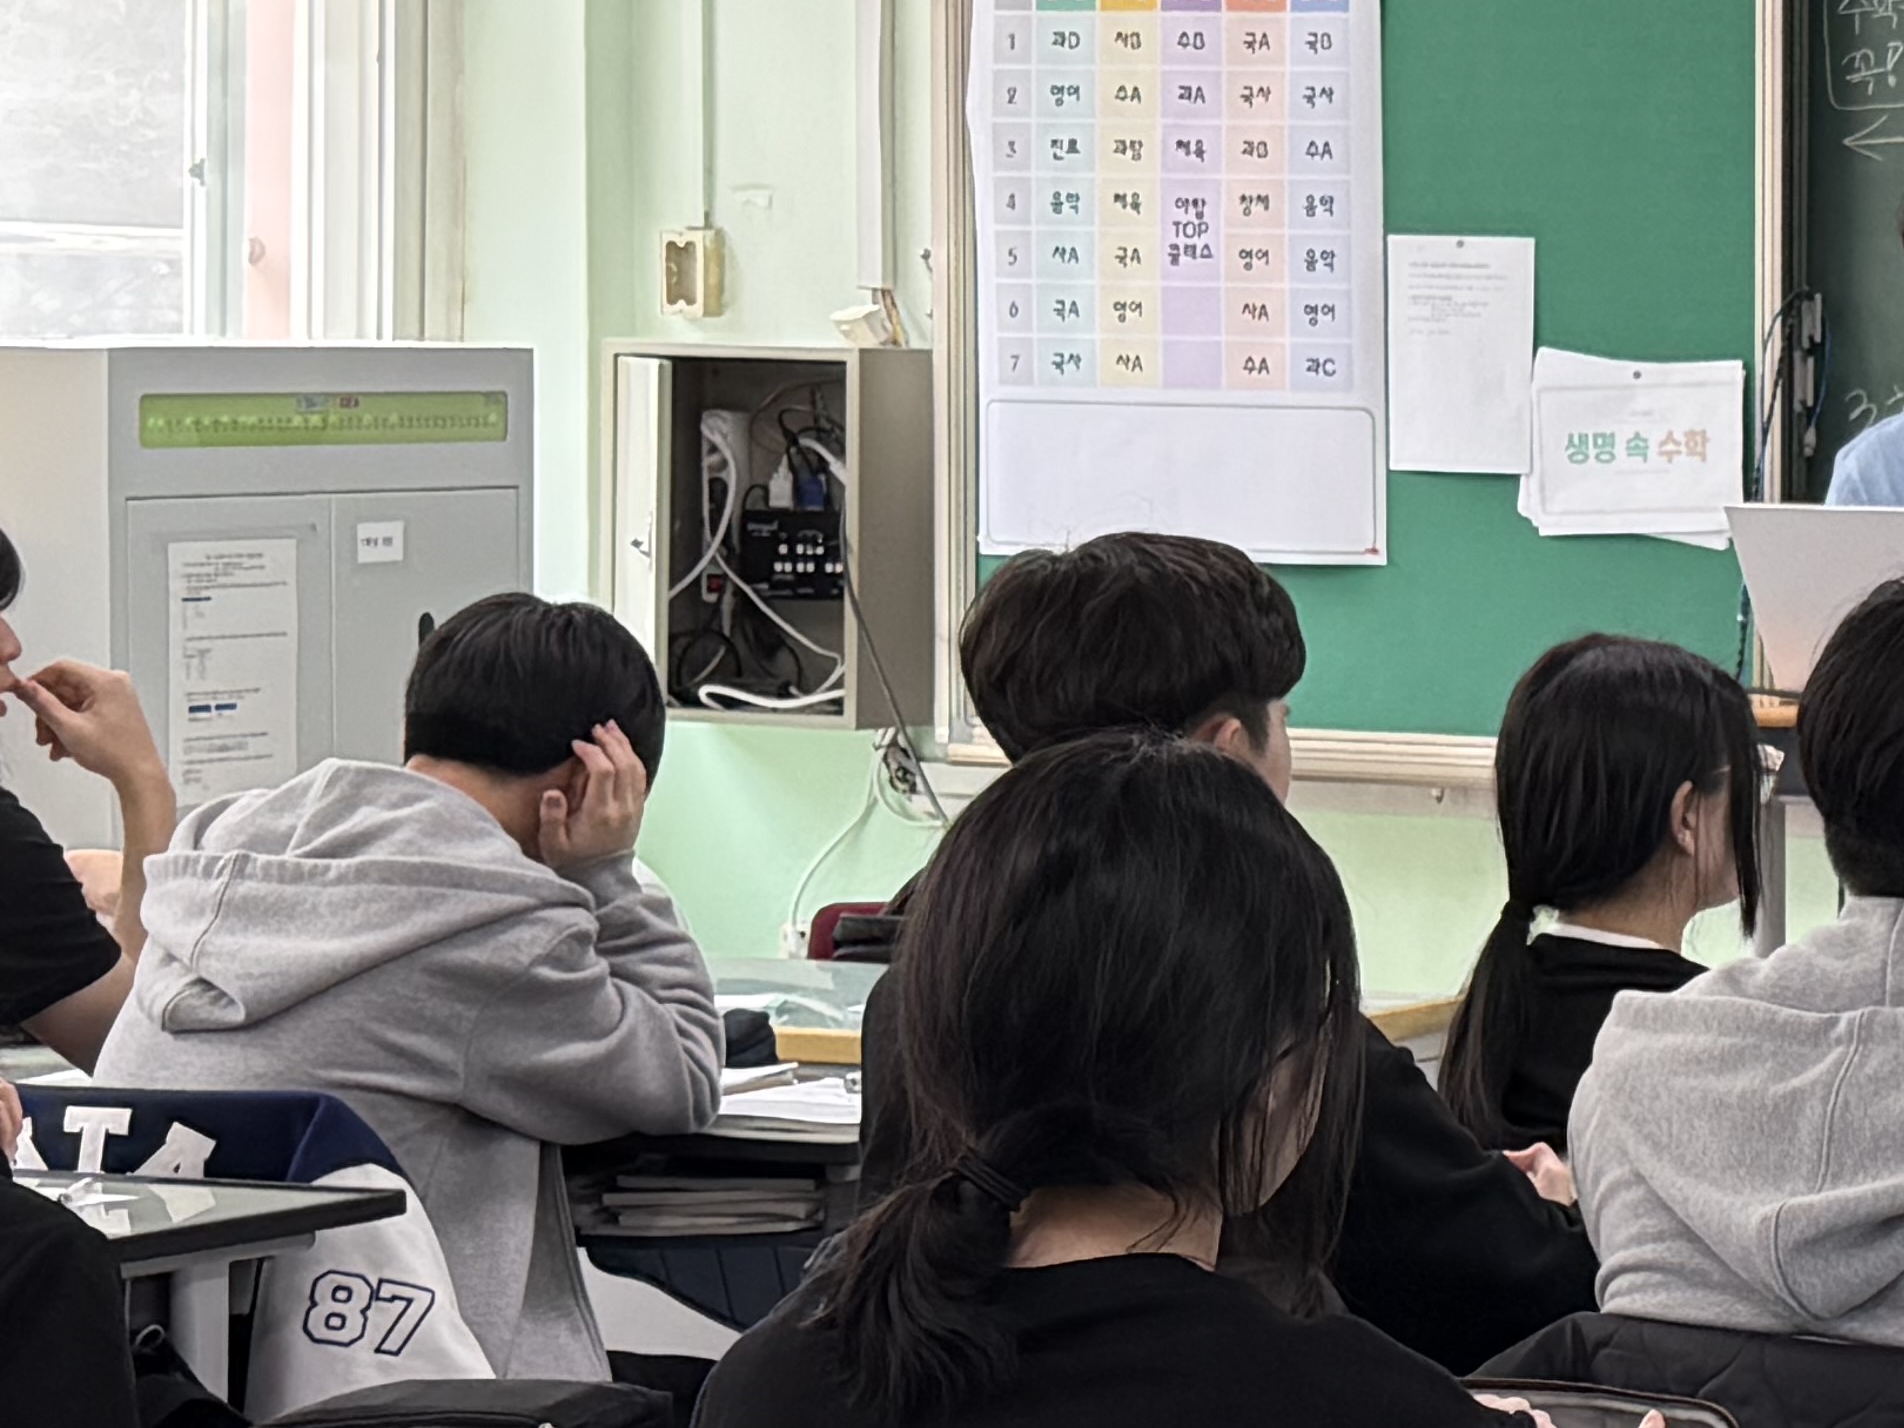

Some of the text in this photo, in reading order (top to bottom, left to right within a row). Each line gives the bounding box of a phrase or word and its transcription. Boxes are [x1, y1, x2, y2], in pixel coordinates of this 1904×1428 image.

[1172, 221, 1210, 240] TOP
[1564, 428, 1711, 465] 생명 속 수학
[302, 1269, 435, 1357] 87
